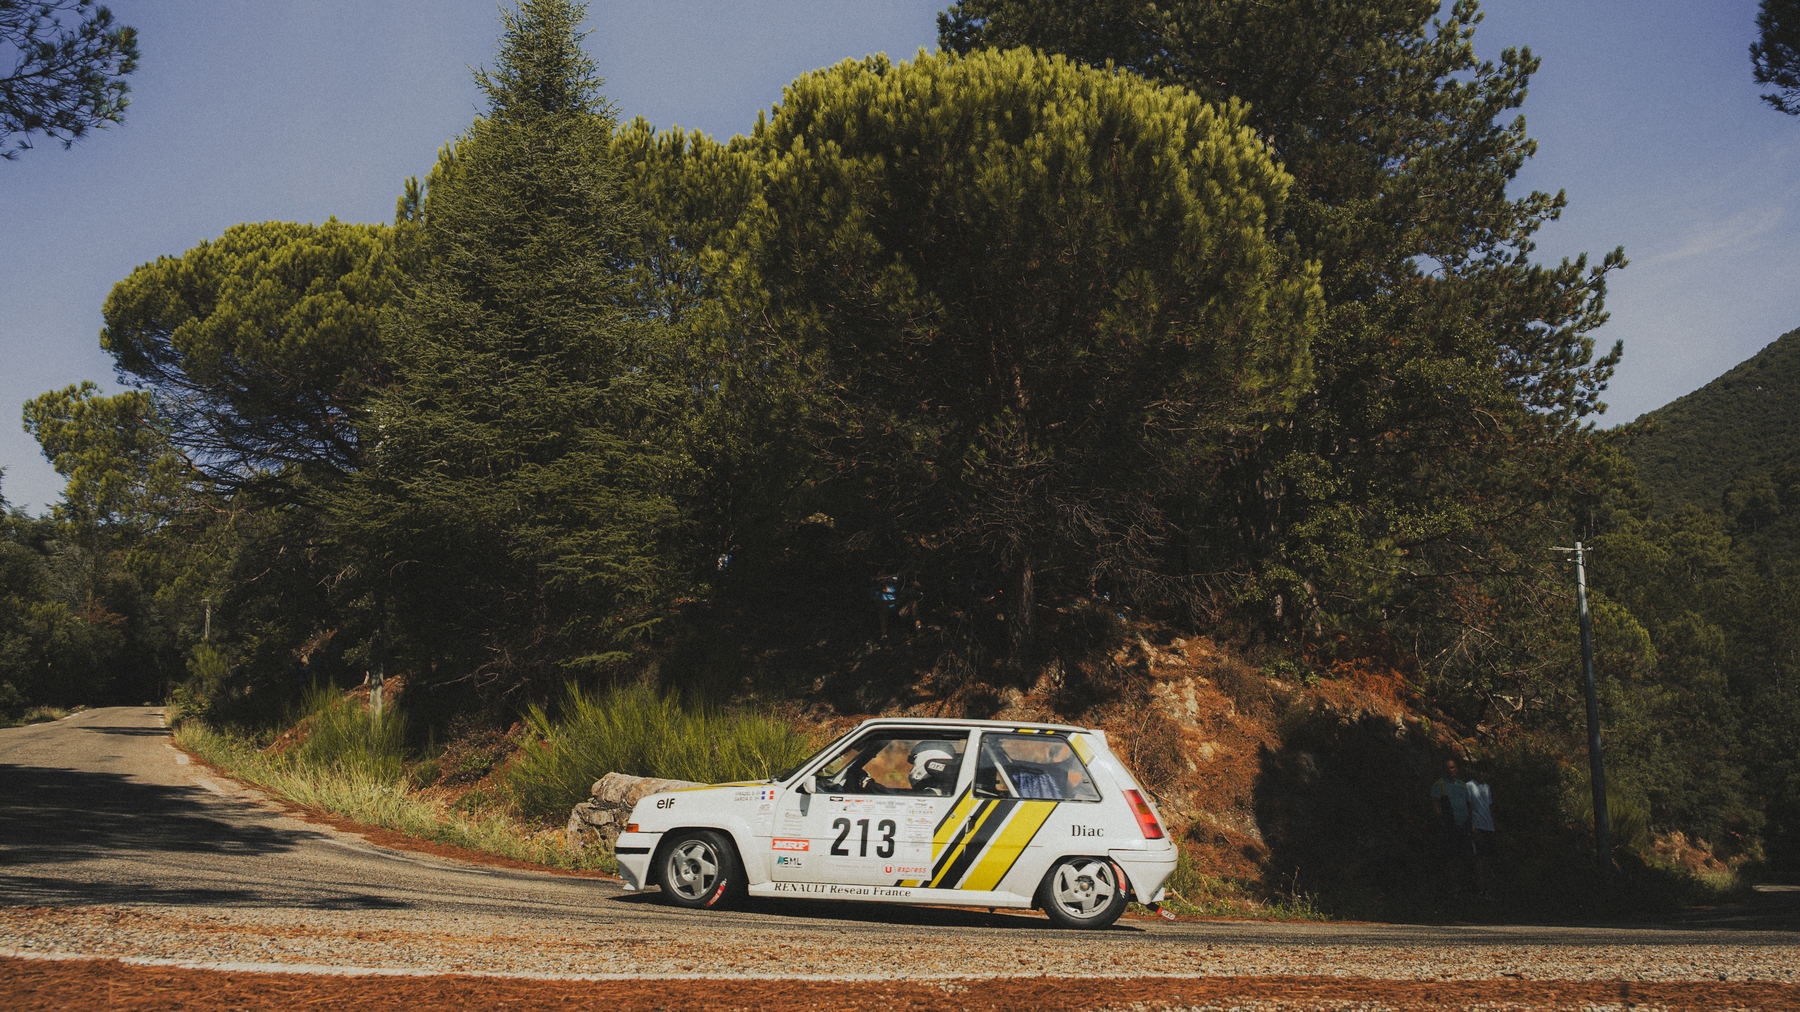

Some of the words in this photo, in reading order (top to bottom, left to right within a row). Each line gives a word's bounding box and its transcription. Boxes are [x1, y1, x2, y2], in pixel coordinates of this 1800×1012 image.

[656, 797, 675, 809] elf
[1071, 824, 1104, 837] Diac
[830, 817, 897, 858] 213
[884, 866, 893, 874] U
[774, 882, 826, 893] RENAULT
[829, 885, 869, 896] Reseau
[873, 887, 911, 897] France
